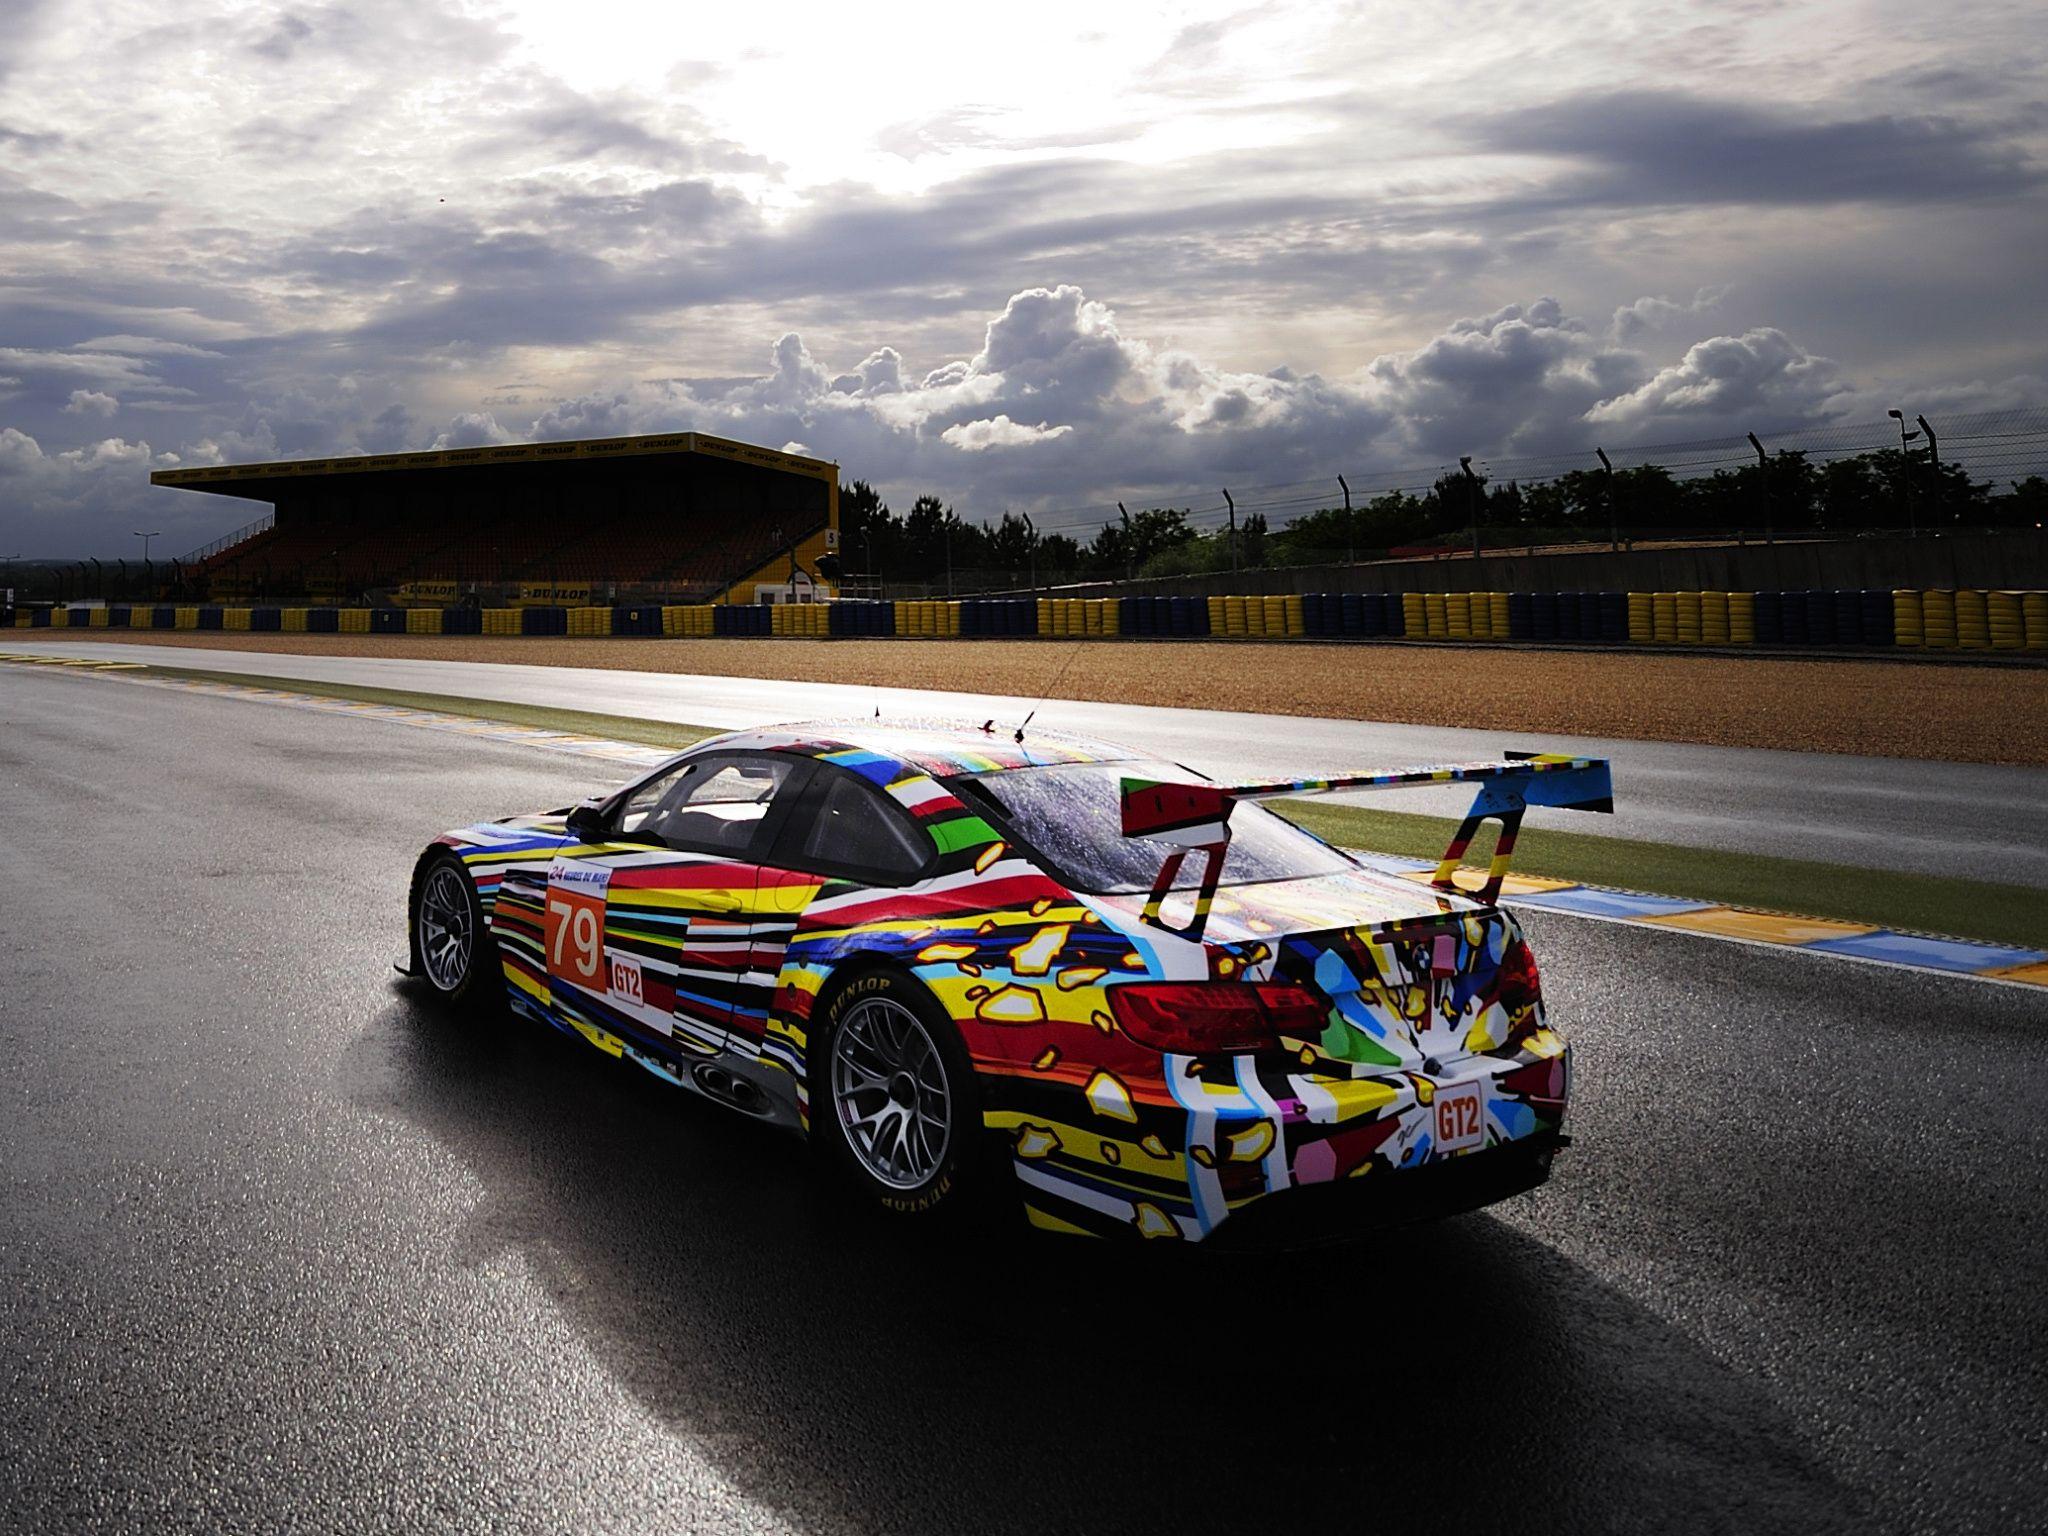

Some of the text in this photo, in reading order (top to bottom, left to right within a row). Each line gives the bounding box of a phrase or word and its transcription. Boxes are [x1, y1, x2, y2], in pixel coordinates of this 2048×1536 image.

[590, 442, 627, 453] DUNLOP
[643, 438, 683, 449] DUNLOP
[703, 442, 737, 452] DUNLOP
[409, 585, 455, 594] DUNLOP
[532, 589, 588, 600] DUNLOP
[549, 866, 565, 880] 24
[550, 900, 599, 977] 79
[615, 964, 640, 996] GT2
[828, 977, 892, 1022] DUNLOP
[1439, 1096, 1479, 1140] GT2
[881, 1175, 952, 1213] DUNLOP
